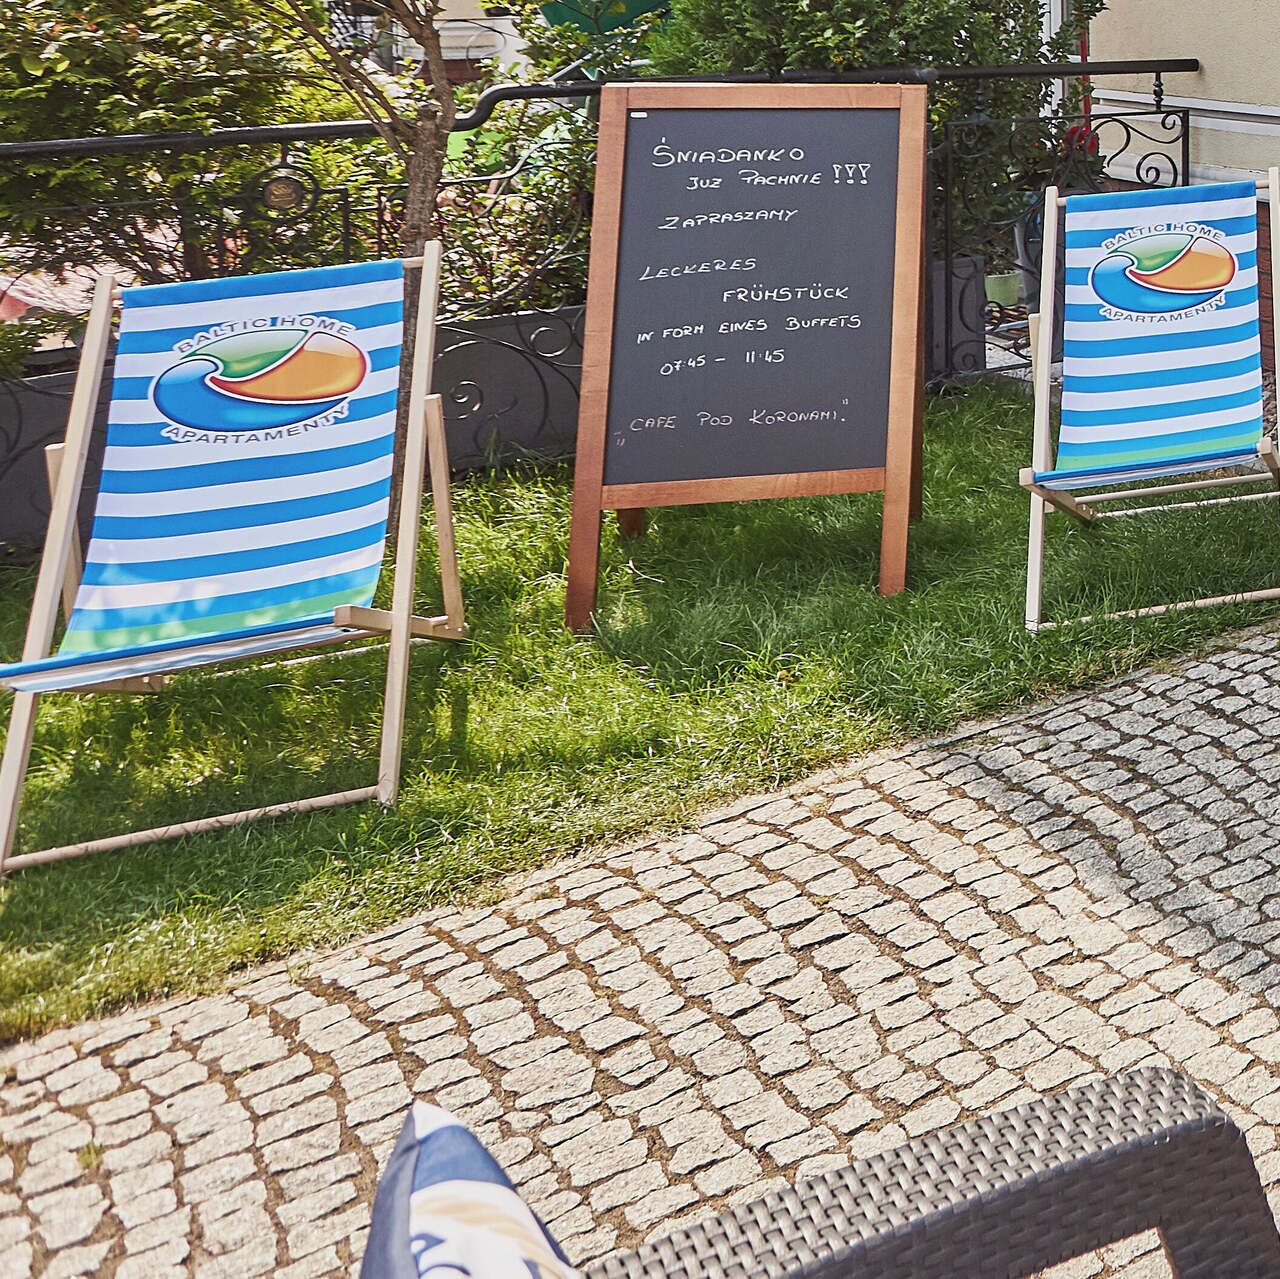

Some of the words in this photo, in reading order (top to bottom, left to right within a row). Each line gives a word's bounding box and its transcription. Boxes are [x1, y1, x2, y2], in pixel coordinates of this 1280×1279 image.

[738, 169, 823, 186] PACHNIE
[657, 208, 799, 231] ZAPRASZAMY
[1104, 224, 1165, 251] BALTIC
[1173, 223, 1223, 241] HOME
[638, 258, 757, 281] LECKERES
[722, 283, 849, 303] FRÜHSTÜCK
[1102, 295, 1226, 323] APARTAMENTY
[176, 316, 271, 354] BALTIC
[280, 316, 353, 336] HOME
[637, 332, 654, 344] IN
[662, 324, 704, 340] FORM
[718, 319, 768, 334] EINES
[785, 315, 862, 331] BUFFETS
[165, 404, 349, 445] APARTAMENTY
[696, 411, 733, 426] POD
